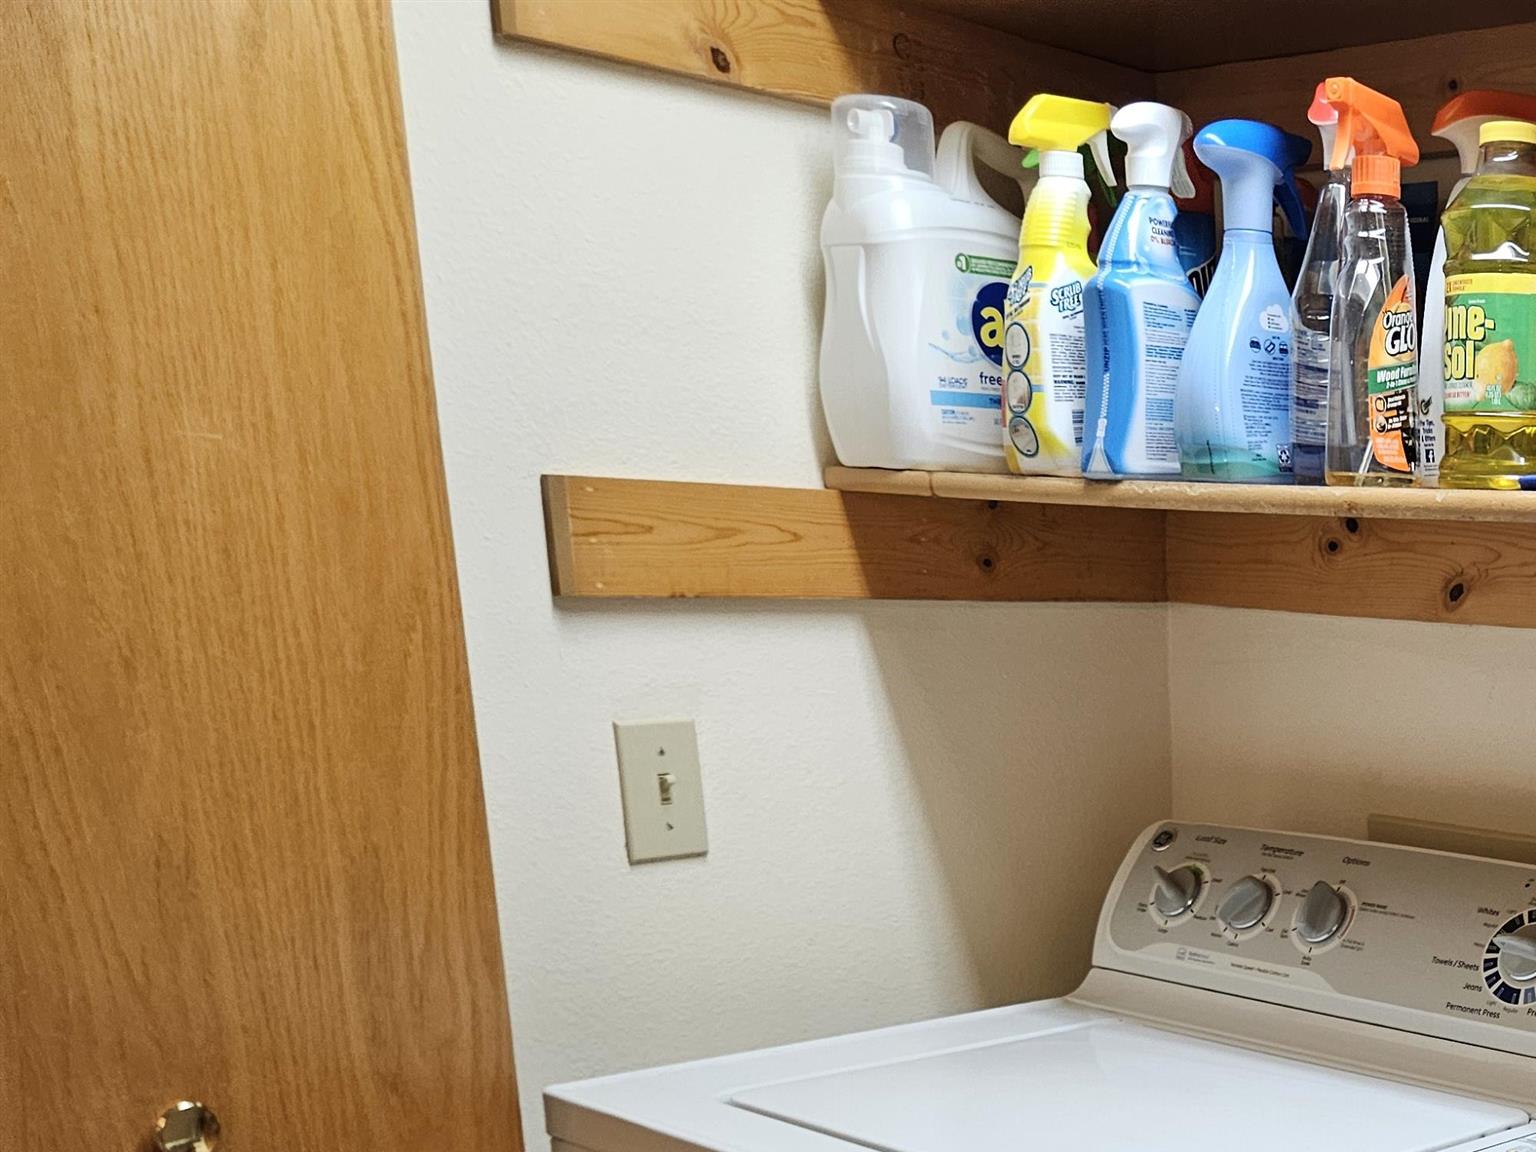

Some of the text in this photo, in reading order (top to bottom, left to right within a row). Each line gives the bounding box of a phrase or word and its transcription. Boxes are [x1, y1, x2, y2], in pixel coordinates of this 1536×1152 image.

[1050, 281, 1082, 306] SCRUB
[1059, 294, 1081, 313] FREE
[1445, 305, 1495, 341] ine-
[1385, 323, 1416, 356] GLO
[979, 372, 1002, 386] free
[1376, 370, 1400, 384] Wood
[1342, 856, 1371, 867] Options
[1432, 956, 1453, 968] Towels
[1457, 960, 1480, 972] Sheets
[1462, 983, 1483, 993] Jeans
[1446, 1001, 1501, 1019] Permanent Press
